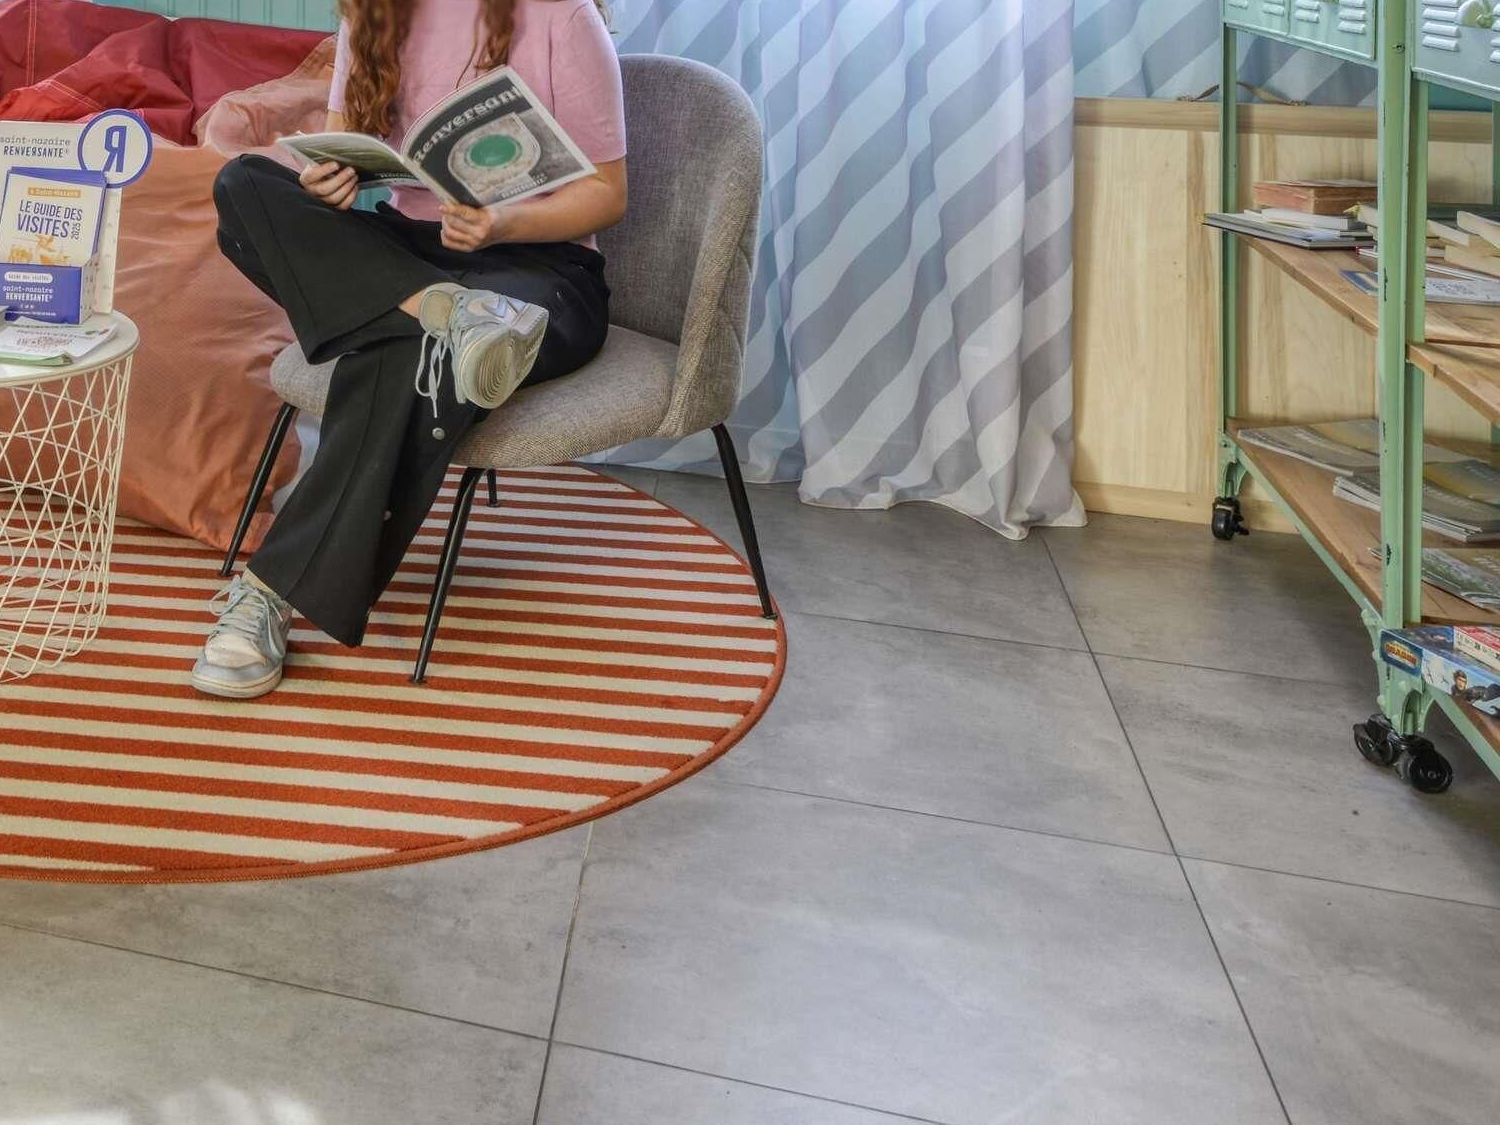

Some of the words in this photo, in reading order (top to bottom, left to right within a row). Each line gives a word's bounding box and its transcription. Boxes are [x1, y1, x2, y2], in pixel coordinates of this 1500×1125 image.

[0, 135, 71, 146] saint-nazaire
[19, 199, 30, 213] LE
[33, 202, 62, 218] GUIDE
[63, 208, 83, 222] DES
[17, 214, 70, 239] VISITES
